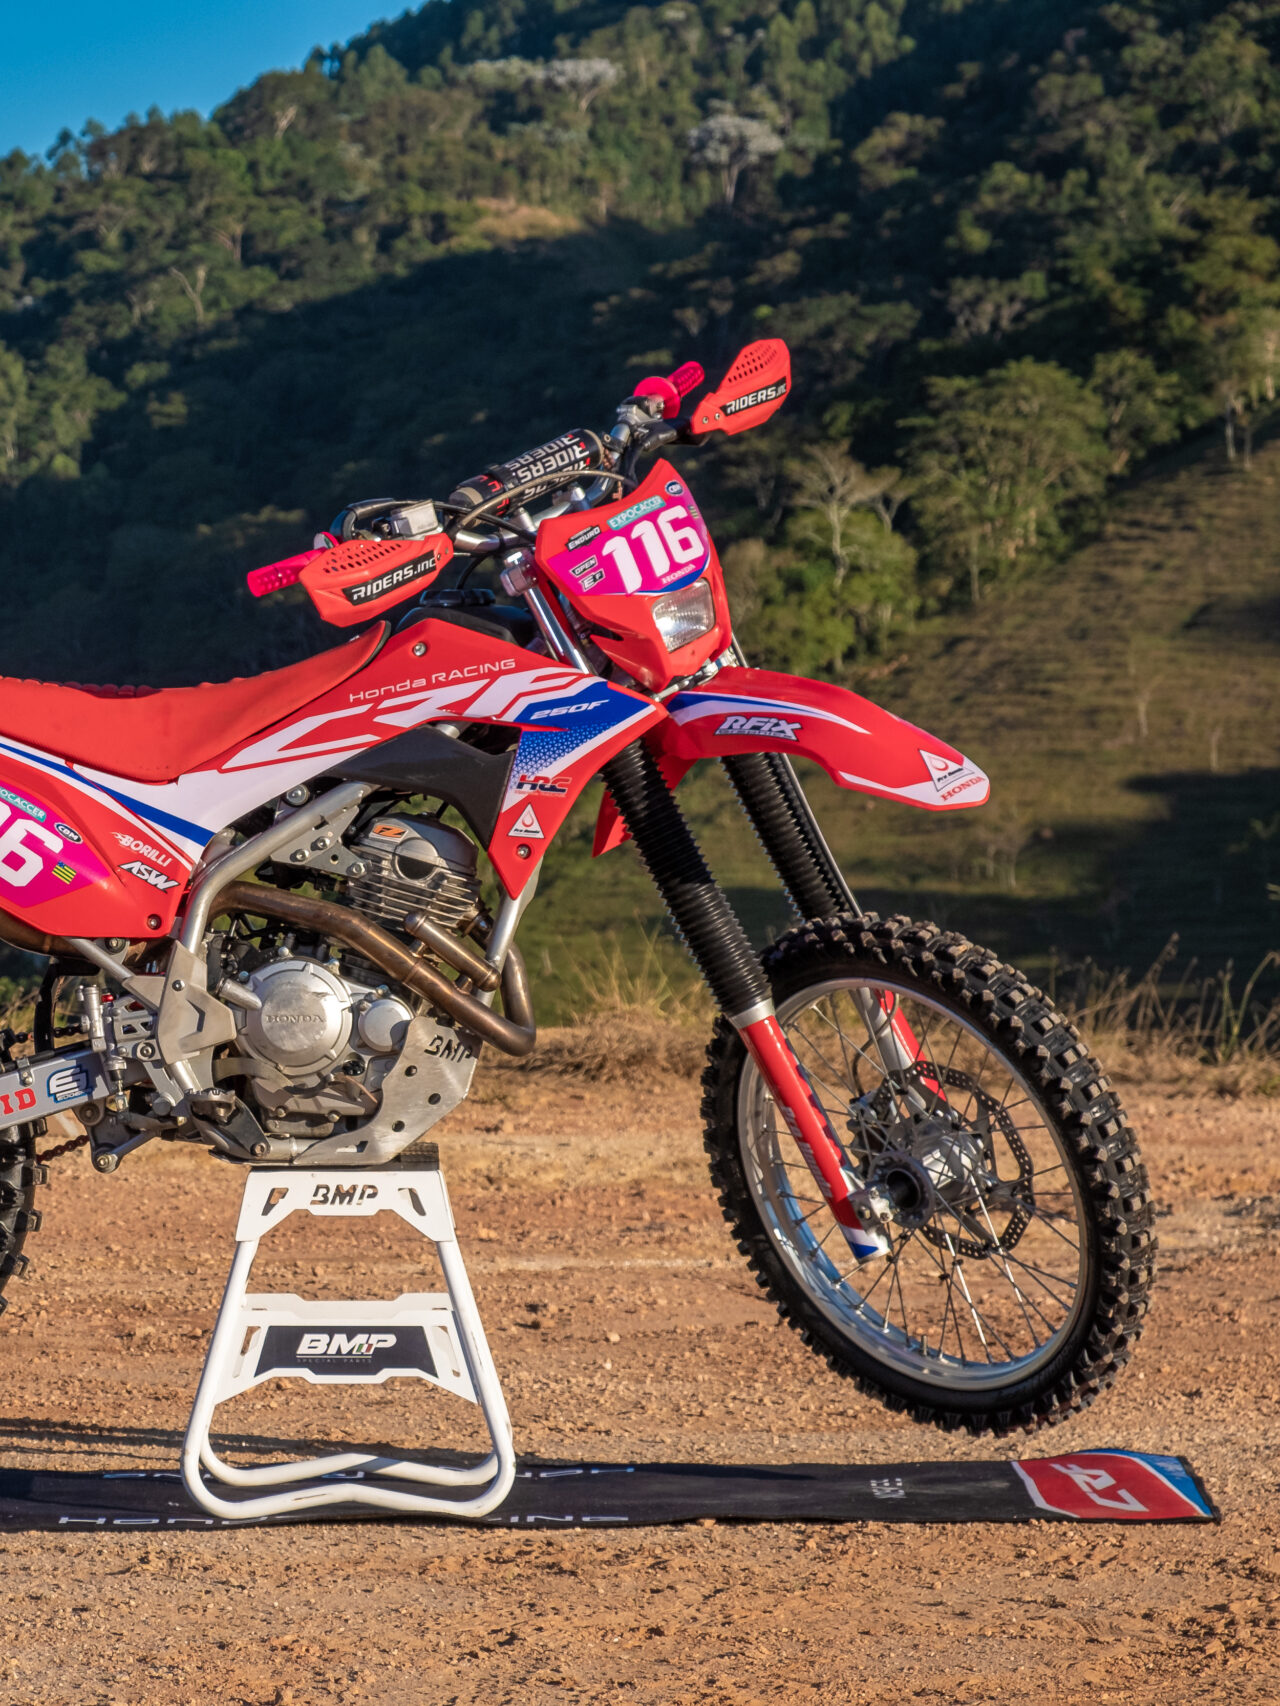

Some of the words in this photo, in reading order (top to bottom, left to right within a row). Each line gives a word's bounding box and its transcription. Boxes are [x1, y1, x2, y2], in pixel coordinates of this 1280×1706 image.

[568, 526, 601, 550] ENDURO
[602, 505, 705, 595] 116
[574, 557, 596, 576] OPEN
[661, 564, 696, 585] HONDA
[349, 679, 427, 703] Honda
[431, 658, 517, 685] RACING
[529, 699, 611, 721] 250F
[516, 774, 573, 794] HRC
[941, 776, 986, 802] HONDA
[57, 825, 80, 842] CBM
[119, 833, 173, 868] BORILLI
[119, 860, 180, 893] ASW
[264, 1013, 326, 1025] HONDA
[310, 1184, 379, 1206] BMP
[296, 1333, 397, 1355] BMP
